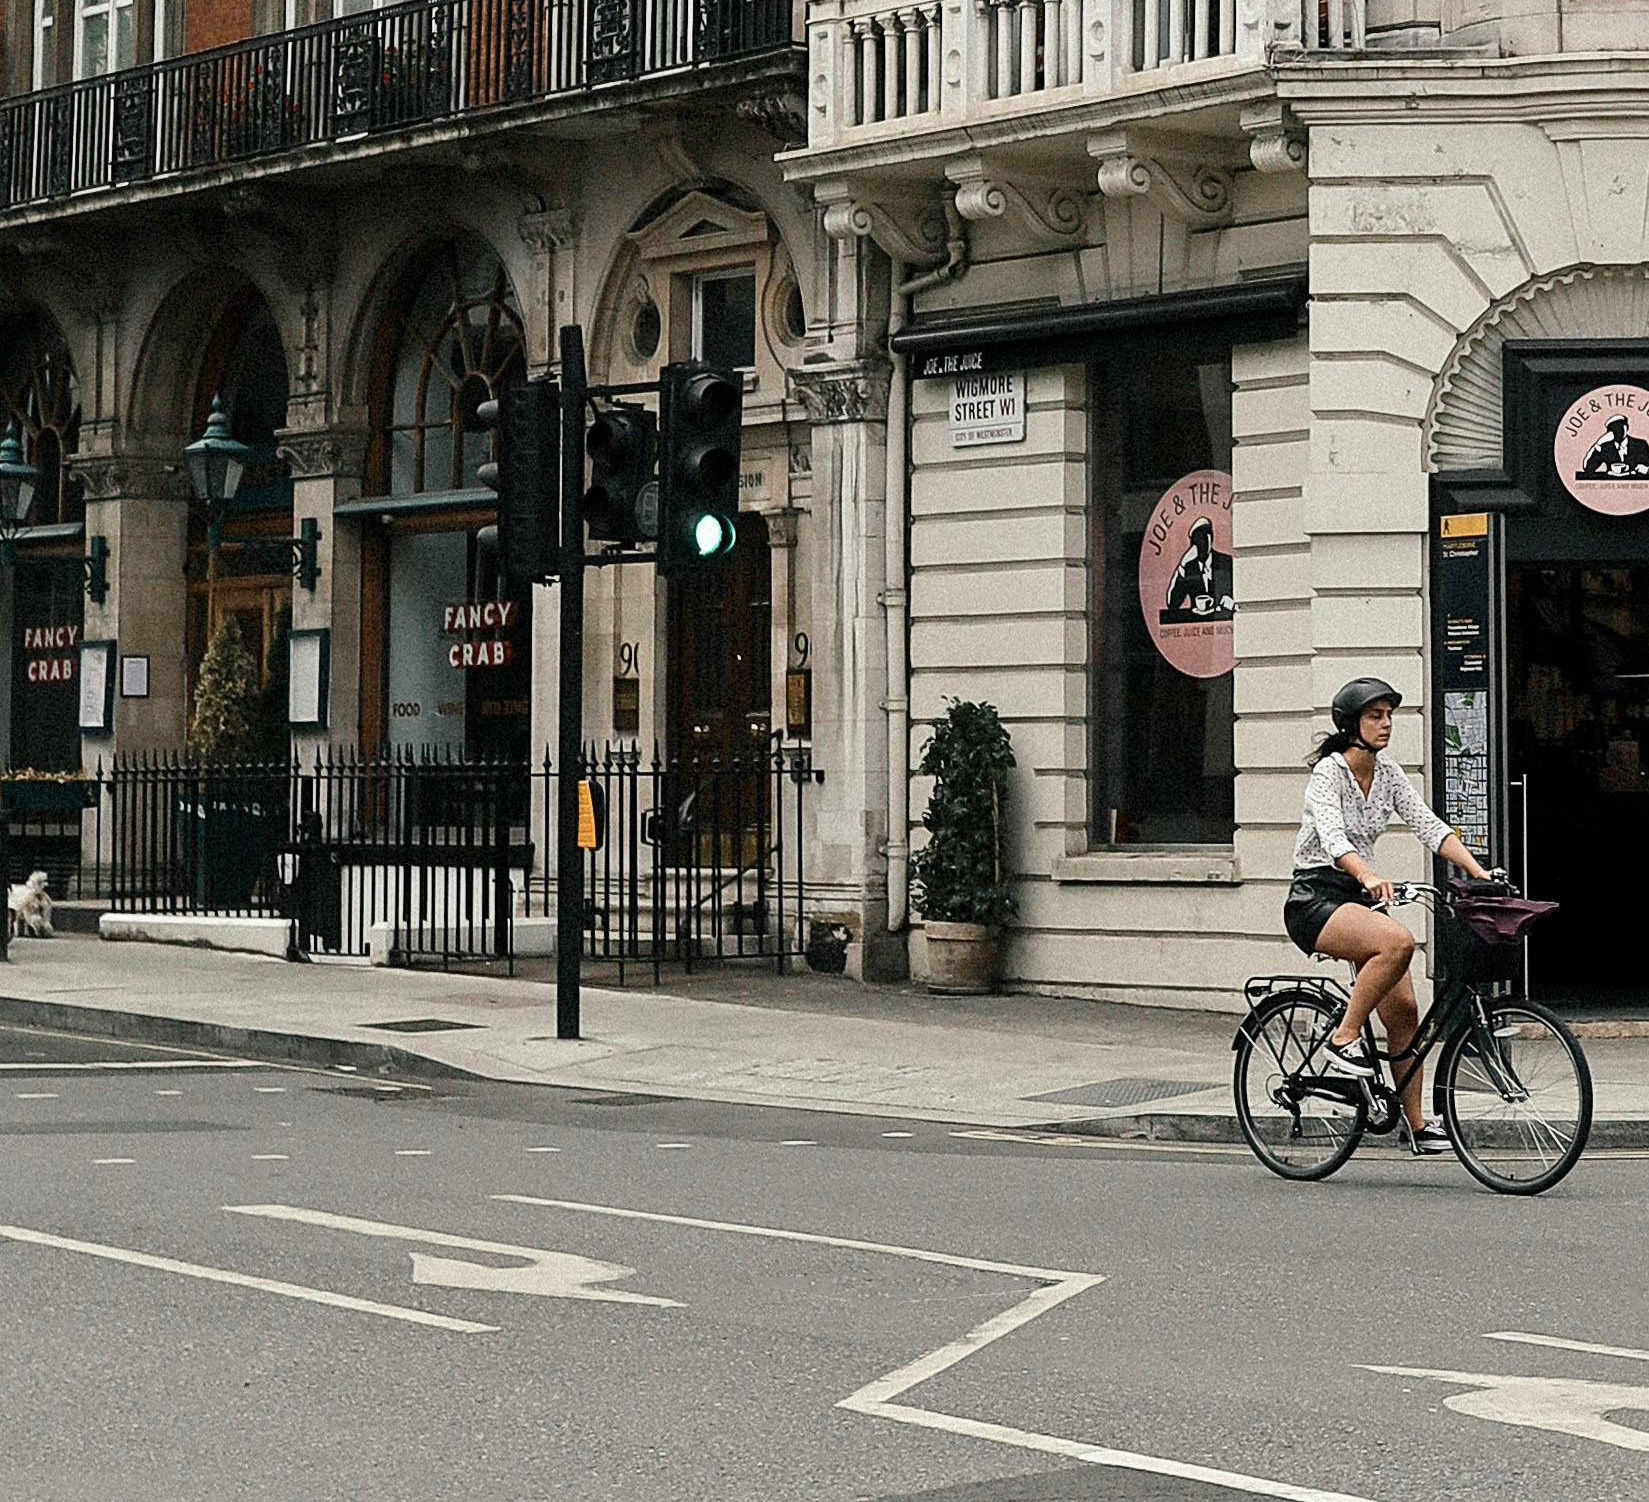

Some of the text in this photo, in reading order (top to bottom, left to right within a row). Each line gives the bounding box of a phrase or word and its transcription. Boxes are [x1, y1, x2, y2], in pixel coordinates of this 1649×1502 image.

[923, 357, 938, 375] JOE
[944, 356, 958, 373] THE
[960, 352, 983, 371] JUICE
[955, 375, 1013, 398] WIGMORE
[955, 398, 1015, 422] STREET W1
[1565, 407, 1590, 438] JOE
[1589, 399, 1602, 413] &
[1604, 393, 1636, 409] THE
[1148, 509, 1174, 557] JOE
[1172, 494, 1186, 516] &
[1189, 482, 1221, 506] THE
[444, 602, 512, 630] FANCY
[24, 625, 78, 648] FANCY
[449, 641, 505, 668] CRAB
[796, 632, 812, 669] 9
[28, 659, 73, 682] CRAB
[392, 702, 421, 717] FOOD
